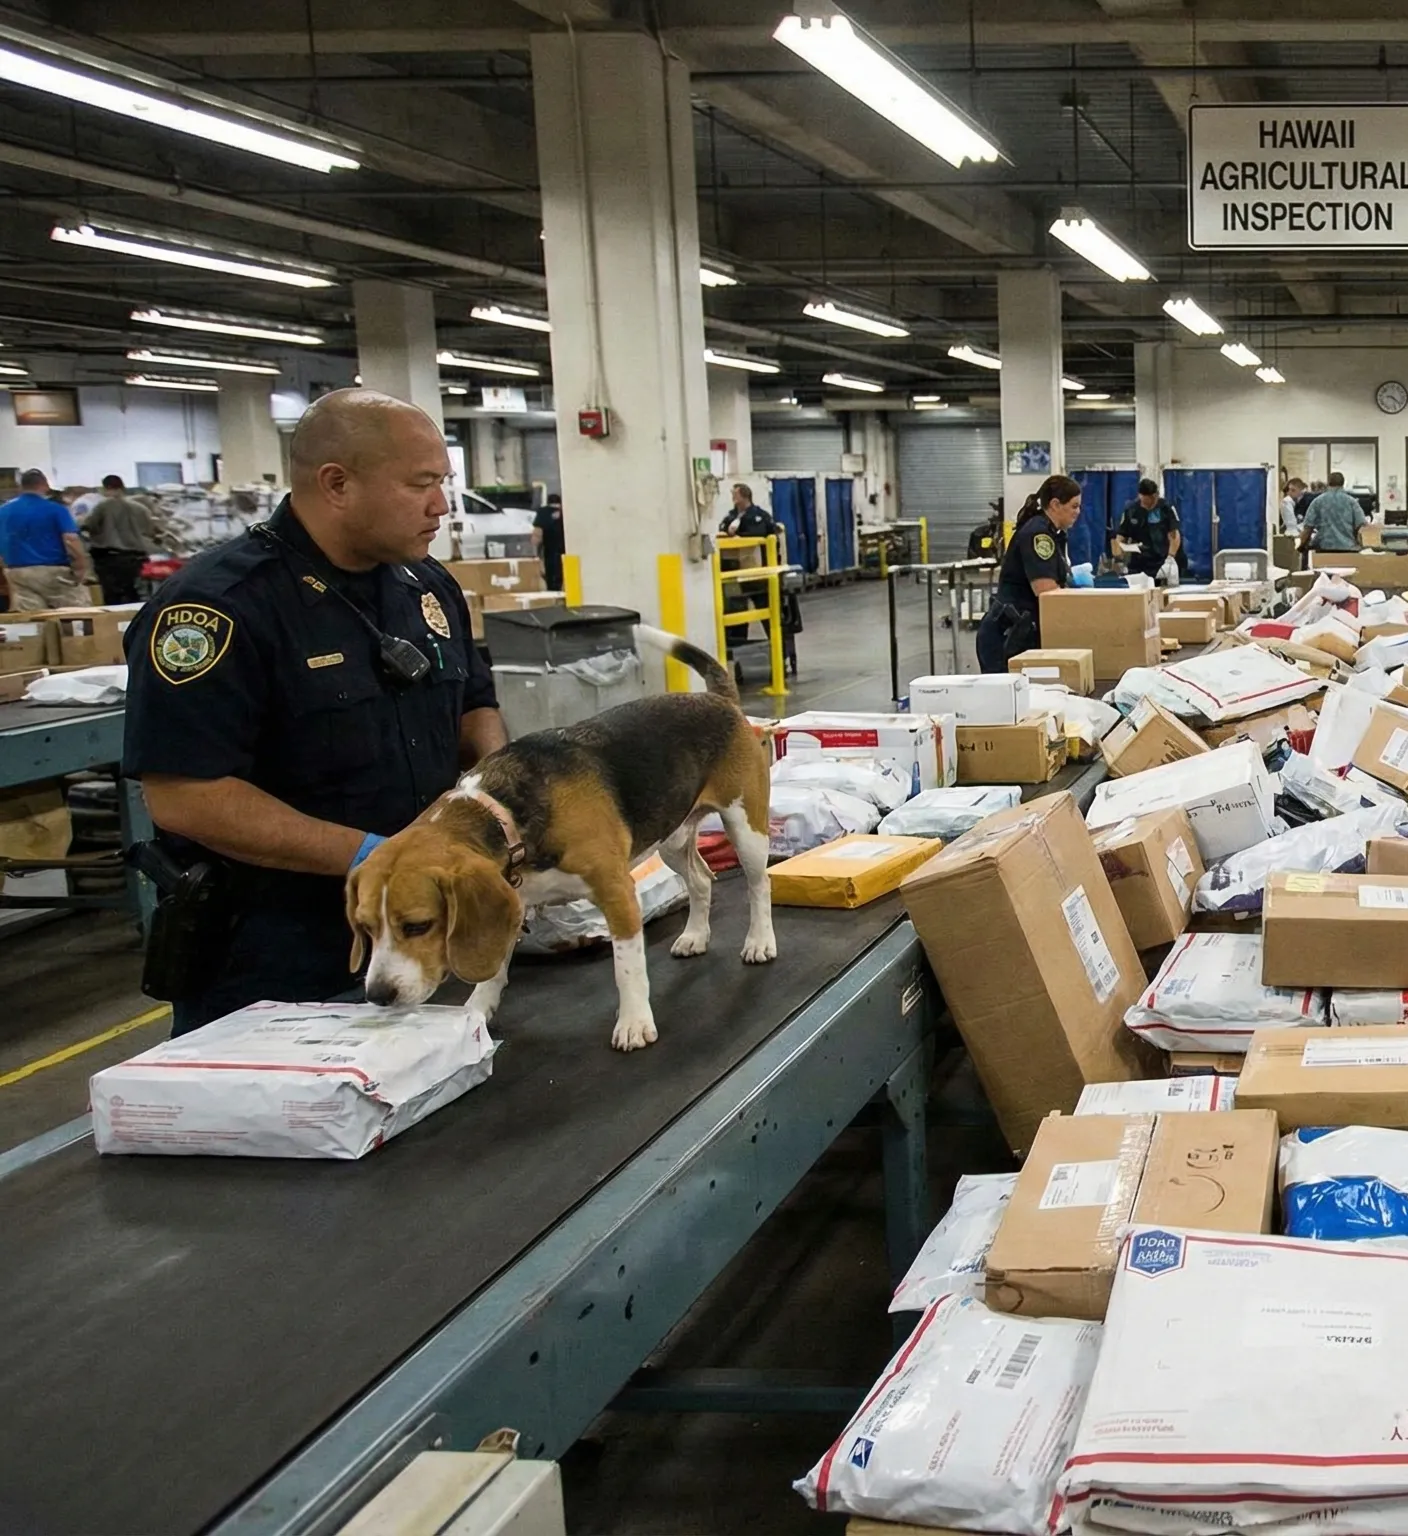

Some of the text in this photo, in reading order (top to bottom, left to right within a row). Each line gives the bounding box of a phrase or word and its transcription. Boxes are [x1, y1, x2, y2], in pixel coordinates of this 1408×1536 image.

[1259, 120, 1355, 148] HAWAII
[1223, 202, 1393, 231] INSPECTION
[167, 610, 219, 633] HDOA
